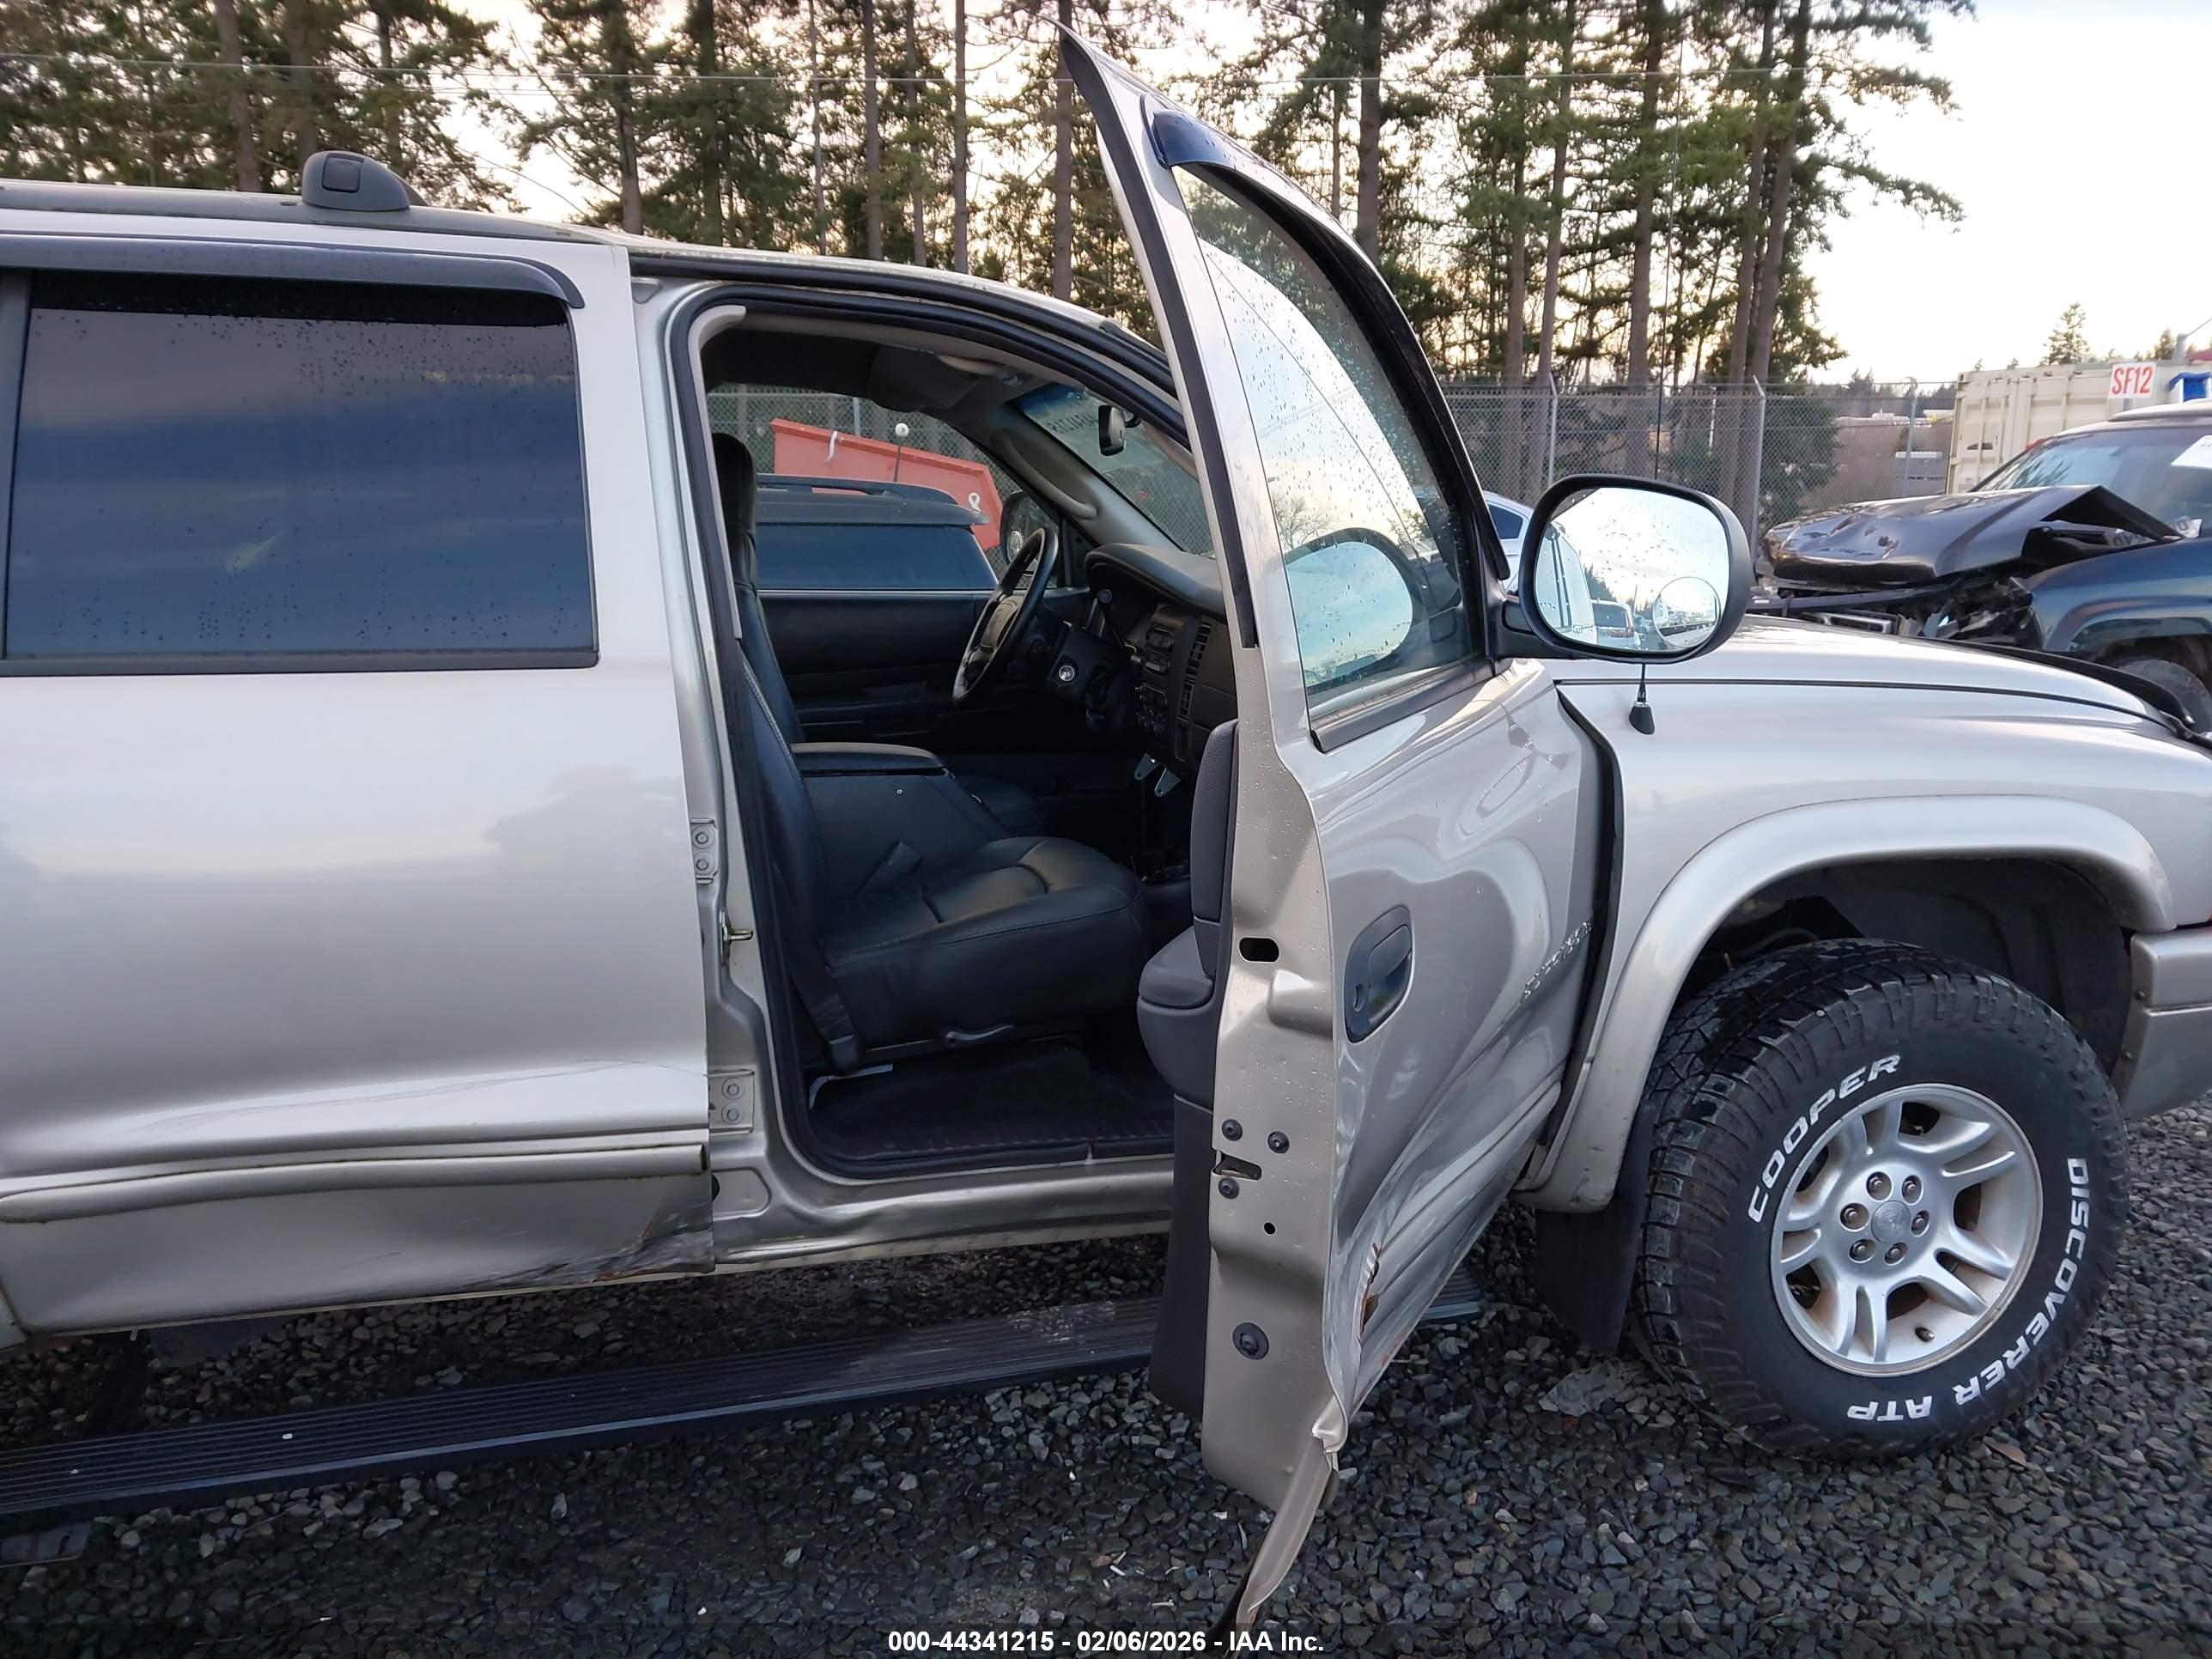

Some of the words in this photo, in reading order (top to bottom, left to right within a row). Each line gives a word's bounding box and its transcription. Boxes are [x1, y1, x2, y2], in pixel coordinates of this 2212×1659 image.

[2112, 366, 2153, 395] SF12
[1747, 1054, 1901, 1223] COOPER
[1952, 1158, 2090, 1406] DISCOVERER
[1846, 1395, 1933, 1422] ATP
